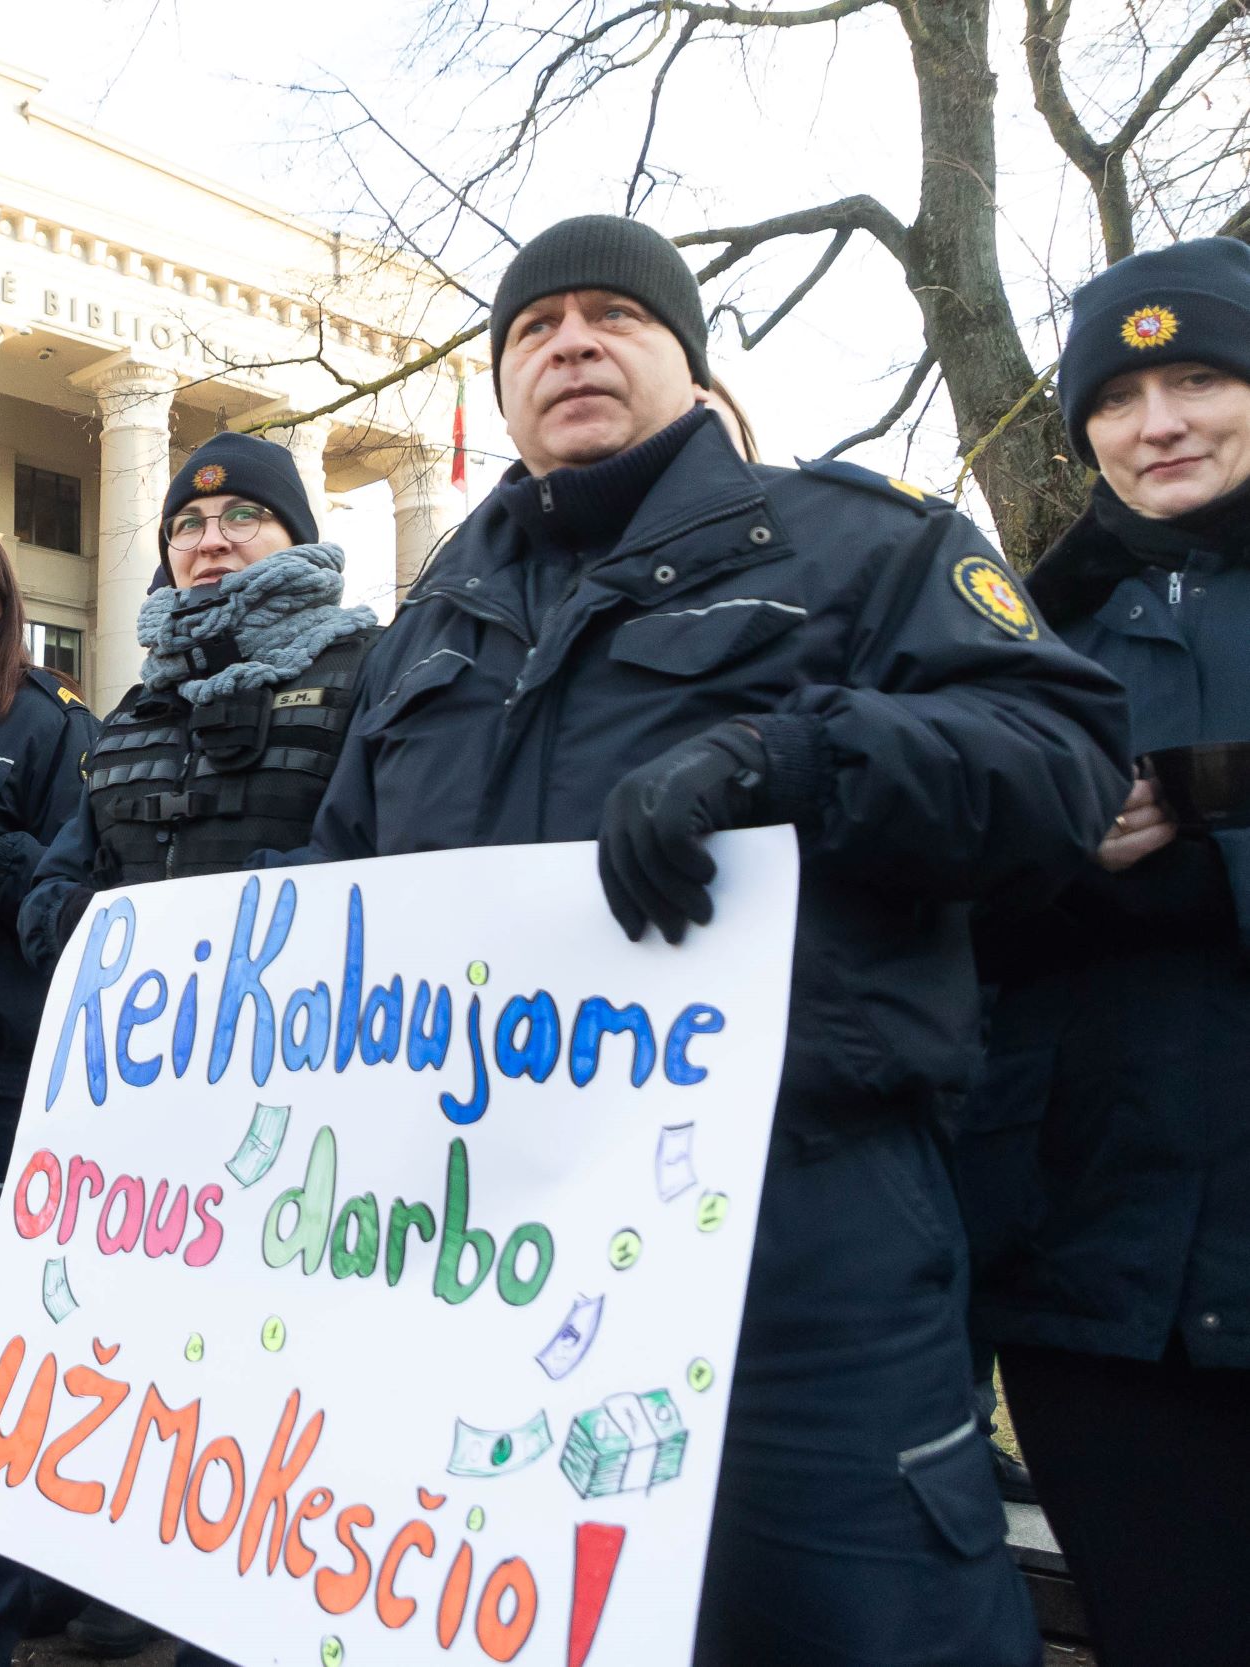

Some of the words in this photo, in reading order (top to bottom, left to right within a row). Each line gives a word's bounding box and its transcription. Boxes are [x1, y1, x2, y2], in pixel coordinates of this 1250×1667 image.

[279, 692, 311, 705] S.M.
[14, 1147, 225, 1268] oraus
[261, 1125, 555, 1306] darbo
